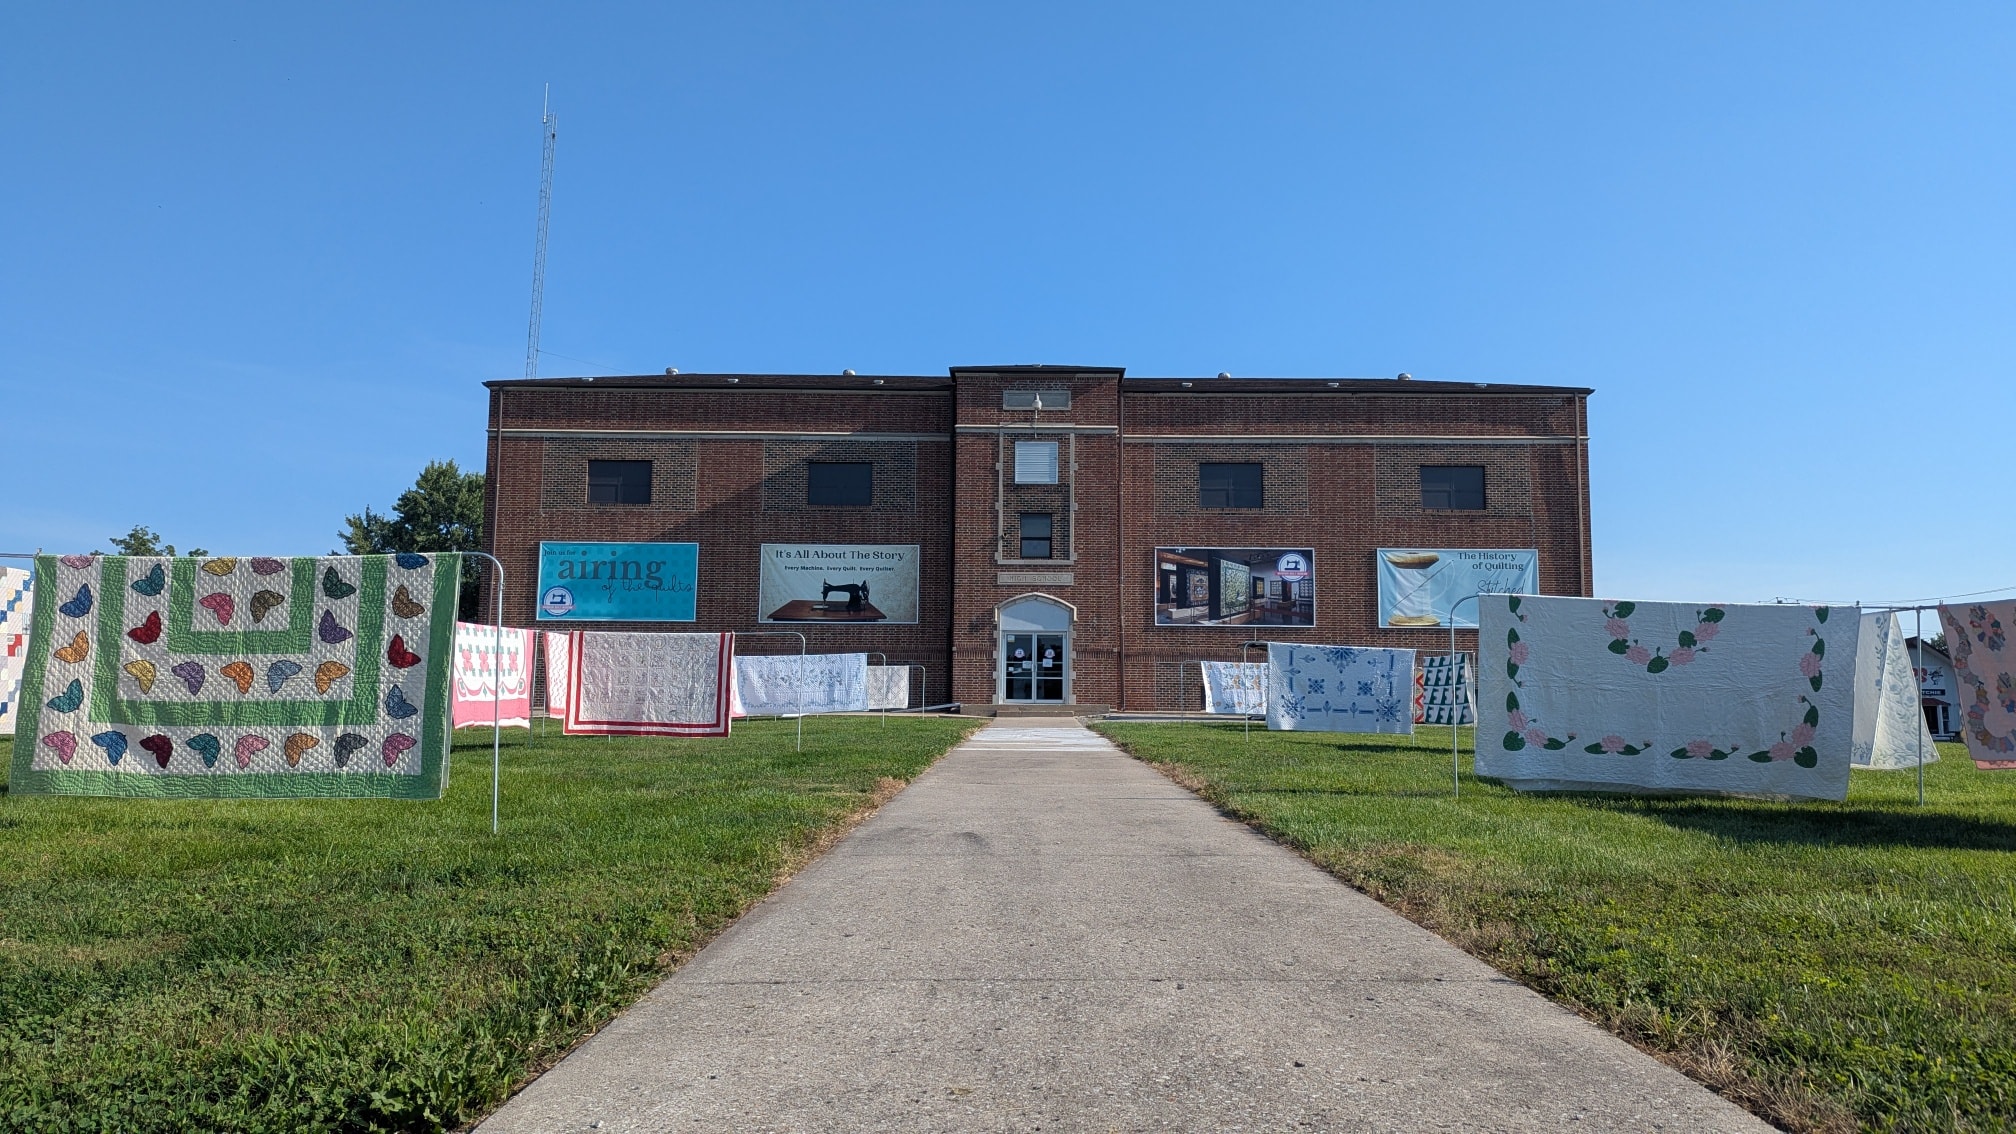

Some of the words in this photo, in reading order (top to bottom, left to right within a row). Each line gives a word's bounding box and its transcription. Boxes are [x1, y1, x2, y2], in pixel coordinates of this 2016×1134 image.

[775, 550, 792, 559] It's
[794, 550, 809, 559] All
[812, 550, 847, 559] About
[849, 550, 870, 559] The
[872, 550, 905, 561] Story
[1458, 552, 1476, 560] The
[1479, 552, 1517, 561] History
[557, 550, 667, 589] airing
[1472, 562, 1483, 570] of
[1485, 562, 1524, 571] Quilting
[602, 576, 616, 604] of
[622, 577, 645, 593] the
[651, 574, 693, 602] quilts
[1477, 578, 1526, 594] Stitched
